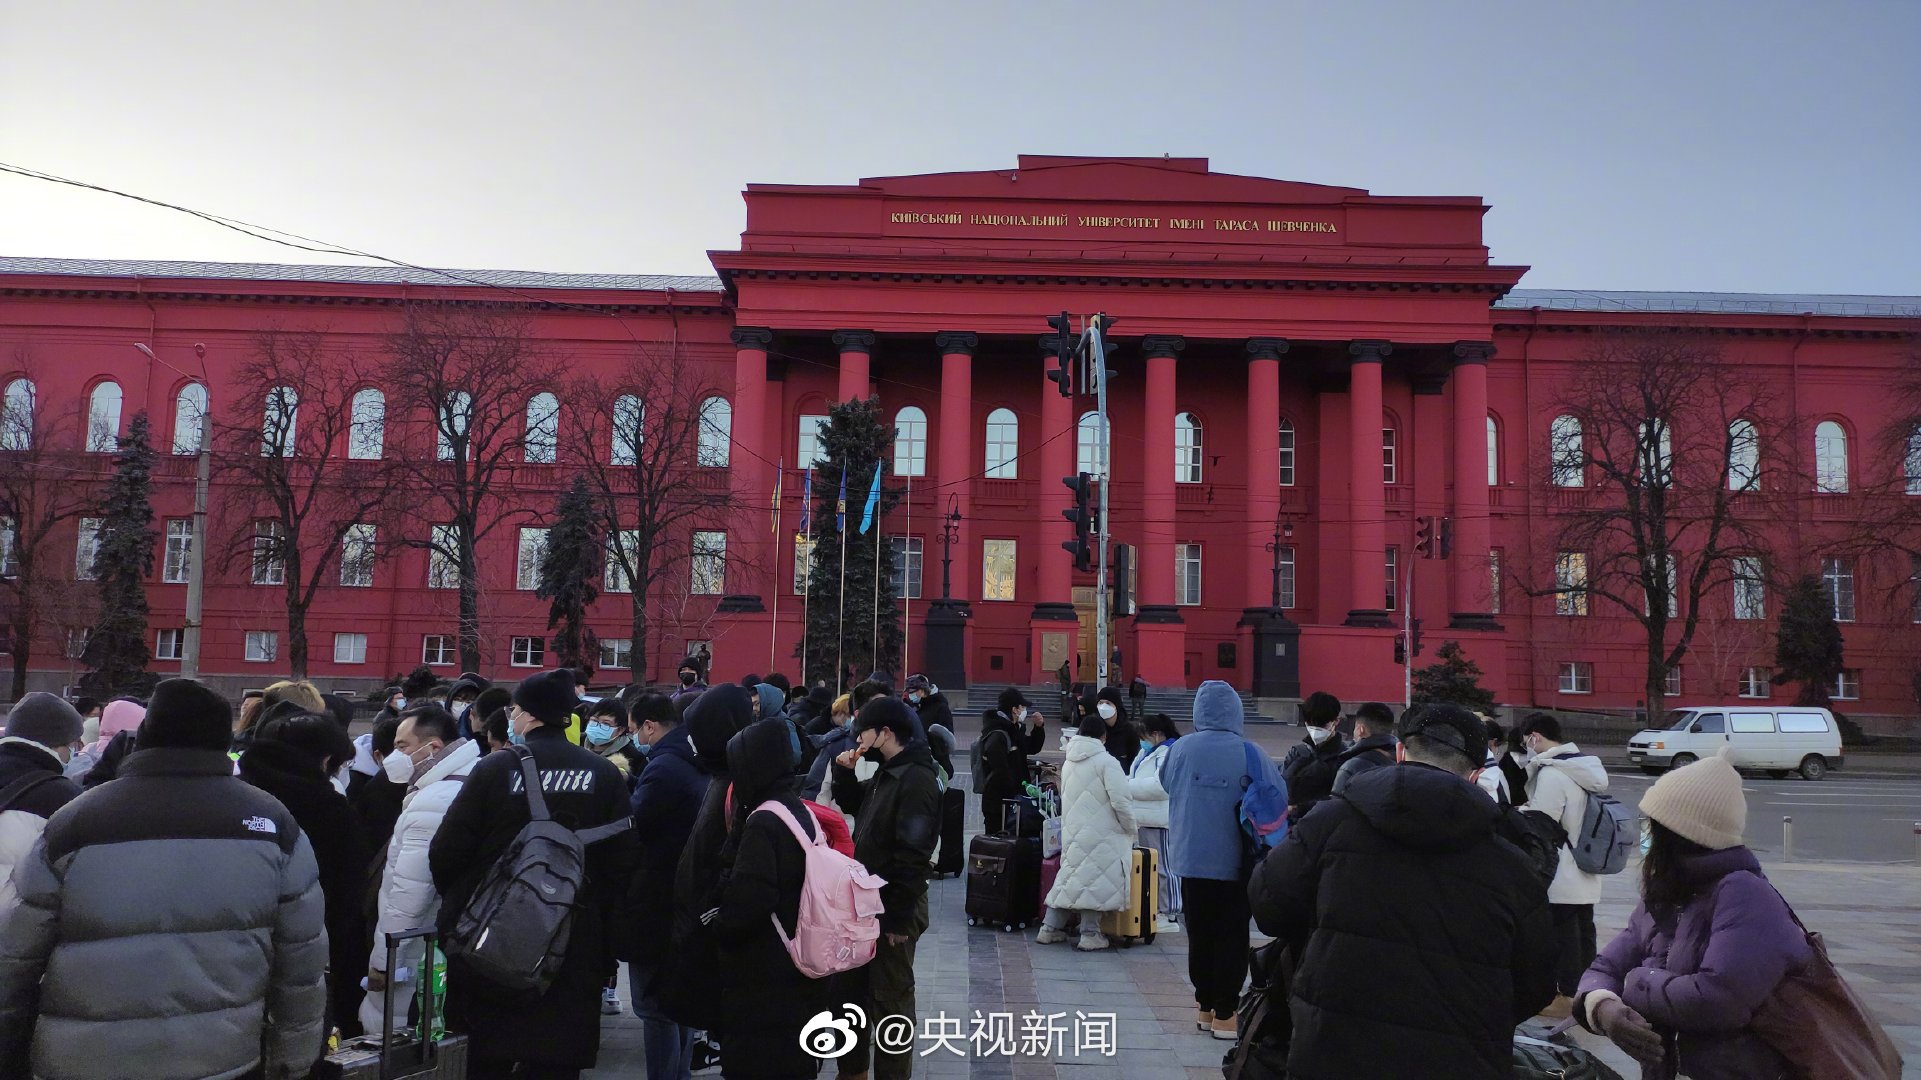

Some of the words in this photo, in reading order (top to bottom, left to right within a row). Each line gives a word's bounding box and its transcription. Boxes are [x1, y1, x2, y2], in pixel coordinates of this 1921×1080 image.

[891, 211, 962, 224] КИЇВСЬКИЙ
[970, 213, 1068, 227] НАЦІОНАЛЬНИЙ
[1078, 216, 1160, 229] УНІВЕРСИТЕТ
[1169, 218, 1204, 230] ІМЕНІ
[1214, 219, 1259, 231] ТАРАСА
[1267, 221, 1337, 233] ШЕВЧЕНКА
